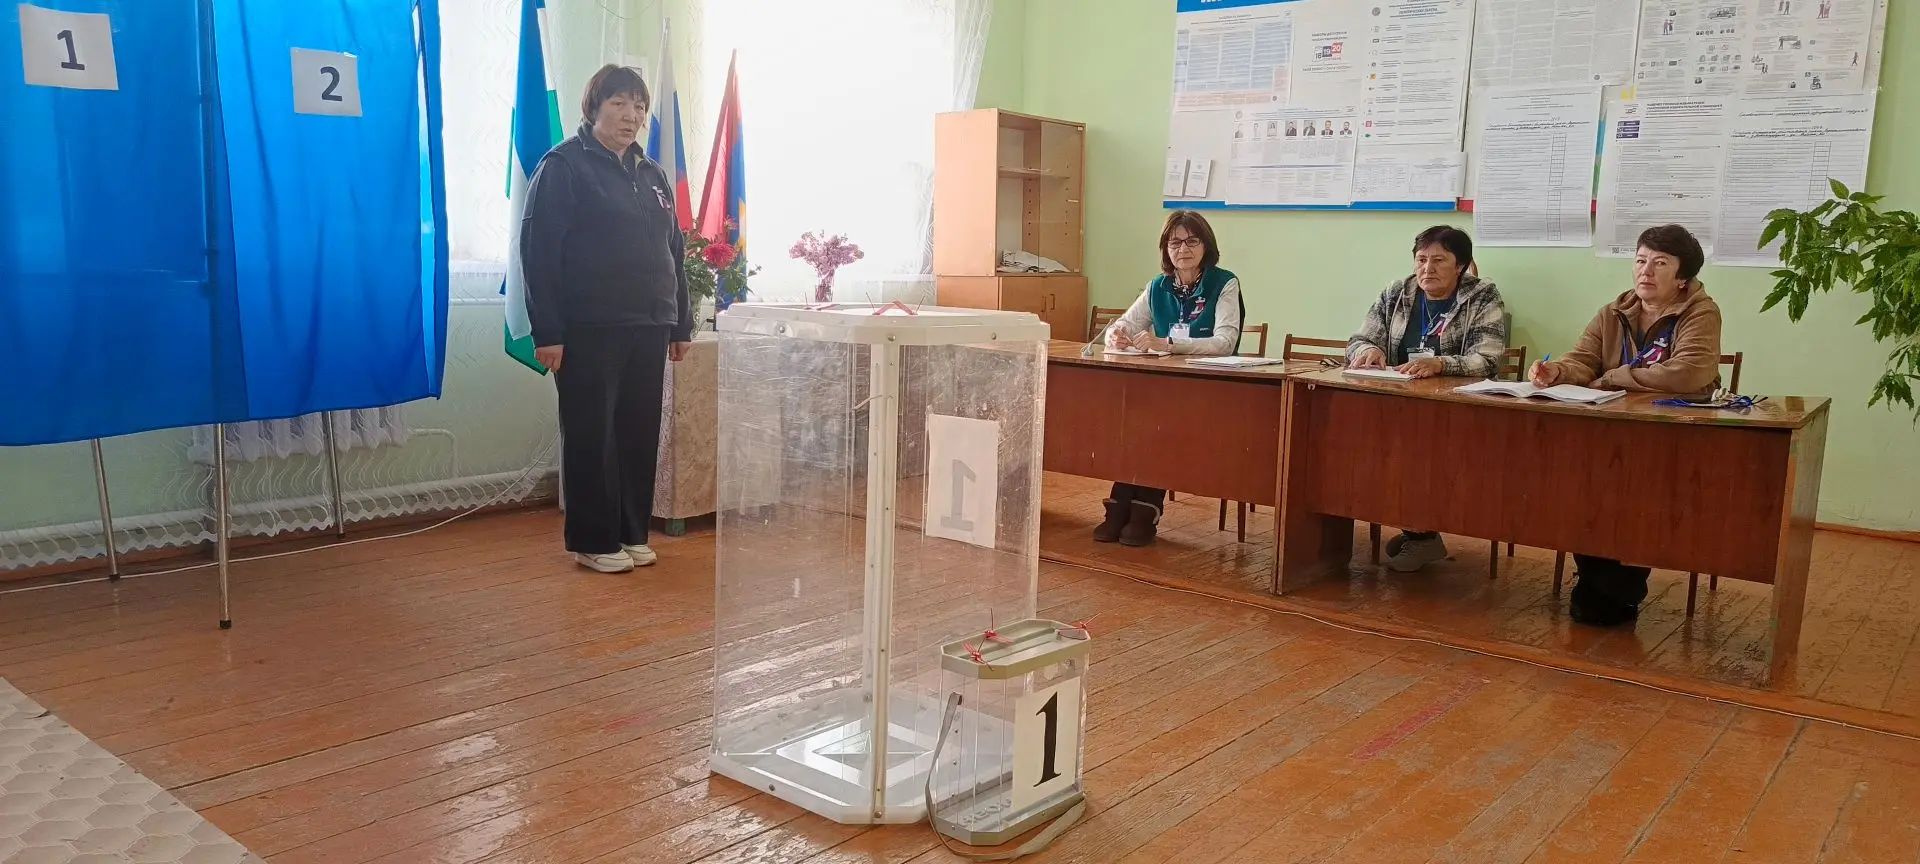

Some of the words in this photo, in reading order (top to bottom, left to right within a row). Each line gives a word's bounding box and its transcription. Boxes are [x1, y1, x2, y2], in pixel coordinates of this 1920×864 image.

[57, 30, 85, 70] 1
[1332, 44, 1341, 52] 20
[320, 67, 342, 101] 2
[1033, 691, 1062, 788] 1
